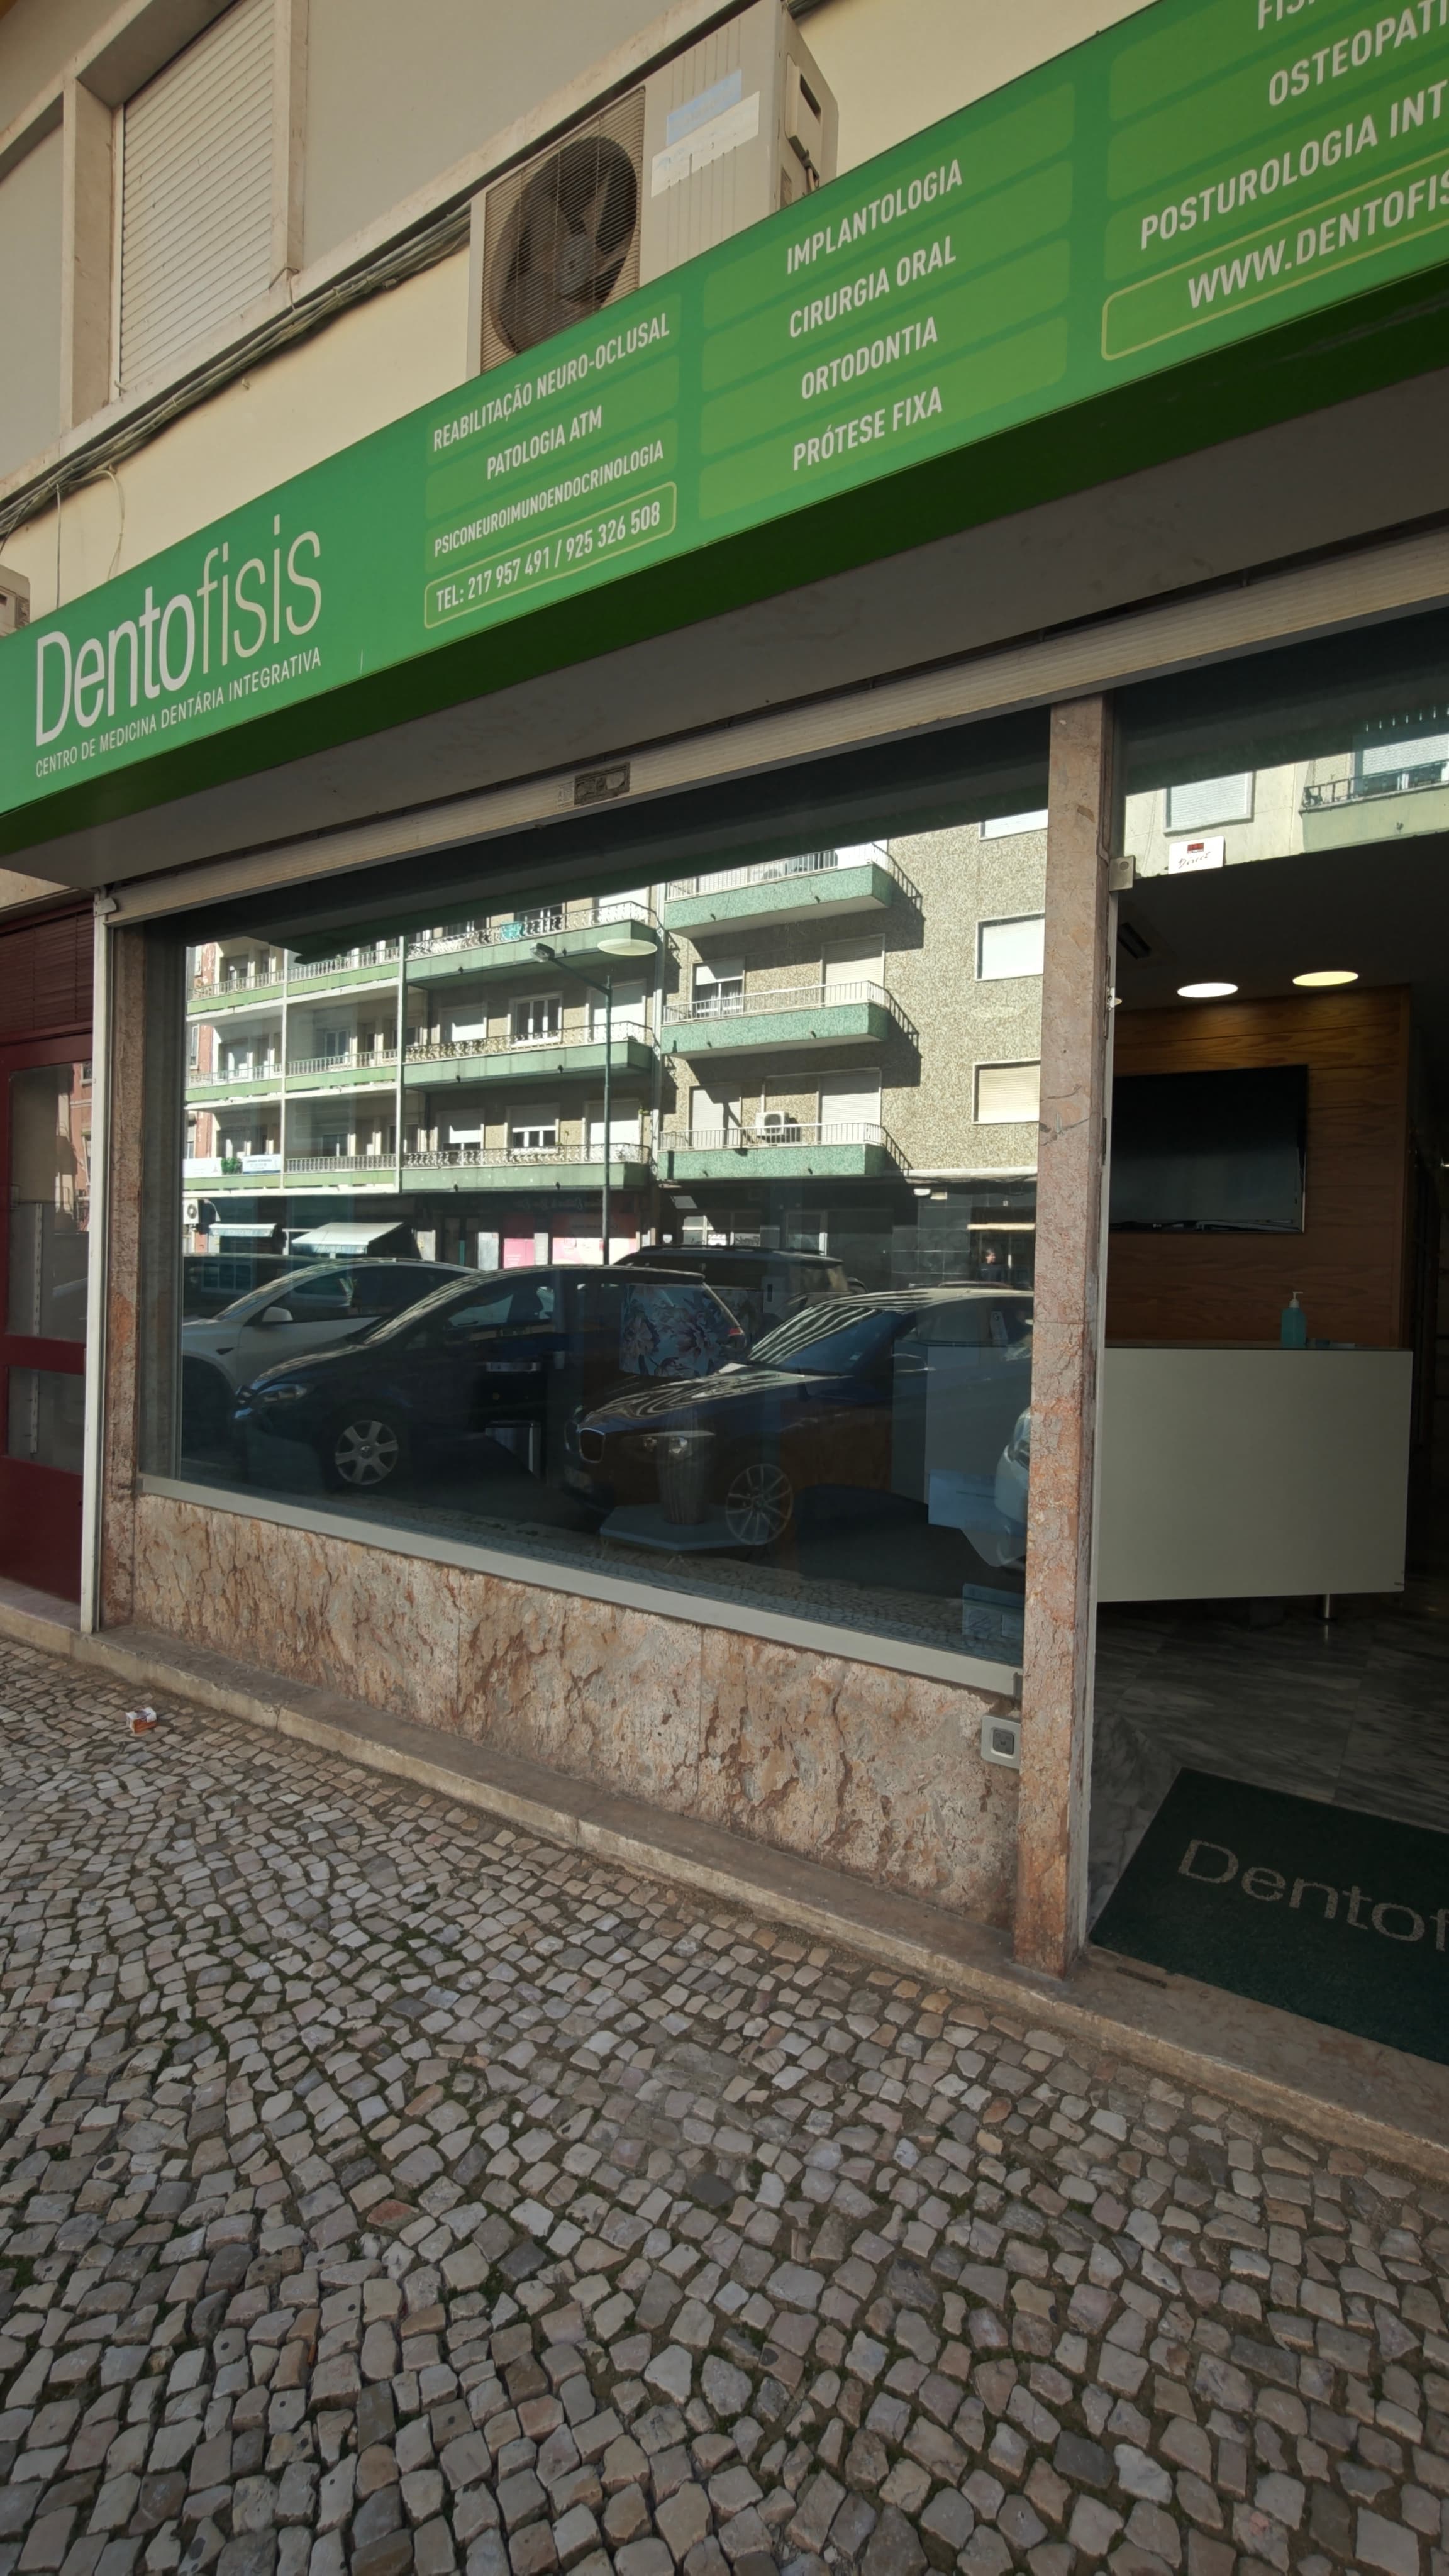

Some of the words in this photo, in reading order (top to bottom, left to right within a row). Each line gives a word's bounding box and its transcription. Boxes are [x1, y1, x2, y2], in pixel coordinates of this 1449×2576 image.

[787, 159, 962, 274] IMPLANTOLOGIA
[1141, 114, 1378, 250] POSTUROLOGIA
[1390, 79, 1448, 138] INT
[789, 268, 889, 337] CIRURGIA
[896, 235, 956, 286] ORAL
[433, 382, 533, 452] REABILITAÇÃO
[536, 313, 669, 399] NEURO-OCLUSAL
[802, 317, 937, 398] ORTODONTIA
[487, 424, 565, 480] PATOLOGIA
[570, 406, 602, 441] ATM
[793, 409, 885, 470] PRÓTESE
[892, 386, 942, 431] FIXA
[435, 440, 664, 557] PSICONEUROIMUNOENDOCRINOLOGIA
[436, 586, 464, 612] TEL:
[468, 570, 492, 600] 217
[496, 558, 521, 586] 957
[525, 547, 550, 576] 491
[553, 539, 563, 567] /
[566, 530, 593, 560] 925
[597, 517, 626, 547] 326
[630, 501, 660, 535] 508
[36, 514, 321, 747] Dentofisis
[36, 745, 78, 778] CENTRO
[81, 738, 96, 762] DE
[99, 714, 157, 752] MEDICINA
[160, 687, 225, 728] DENTÁRIA
[228, 647, 321, 702] INTEGRATIVA
